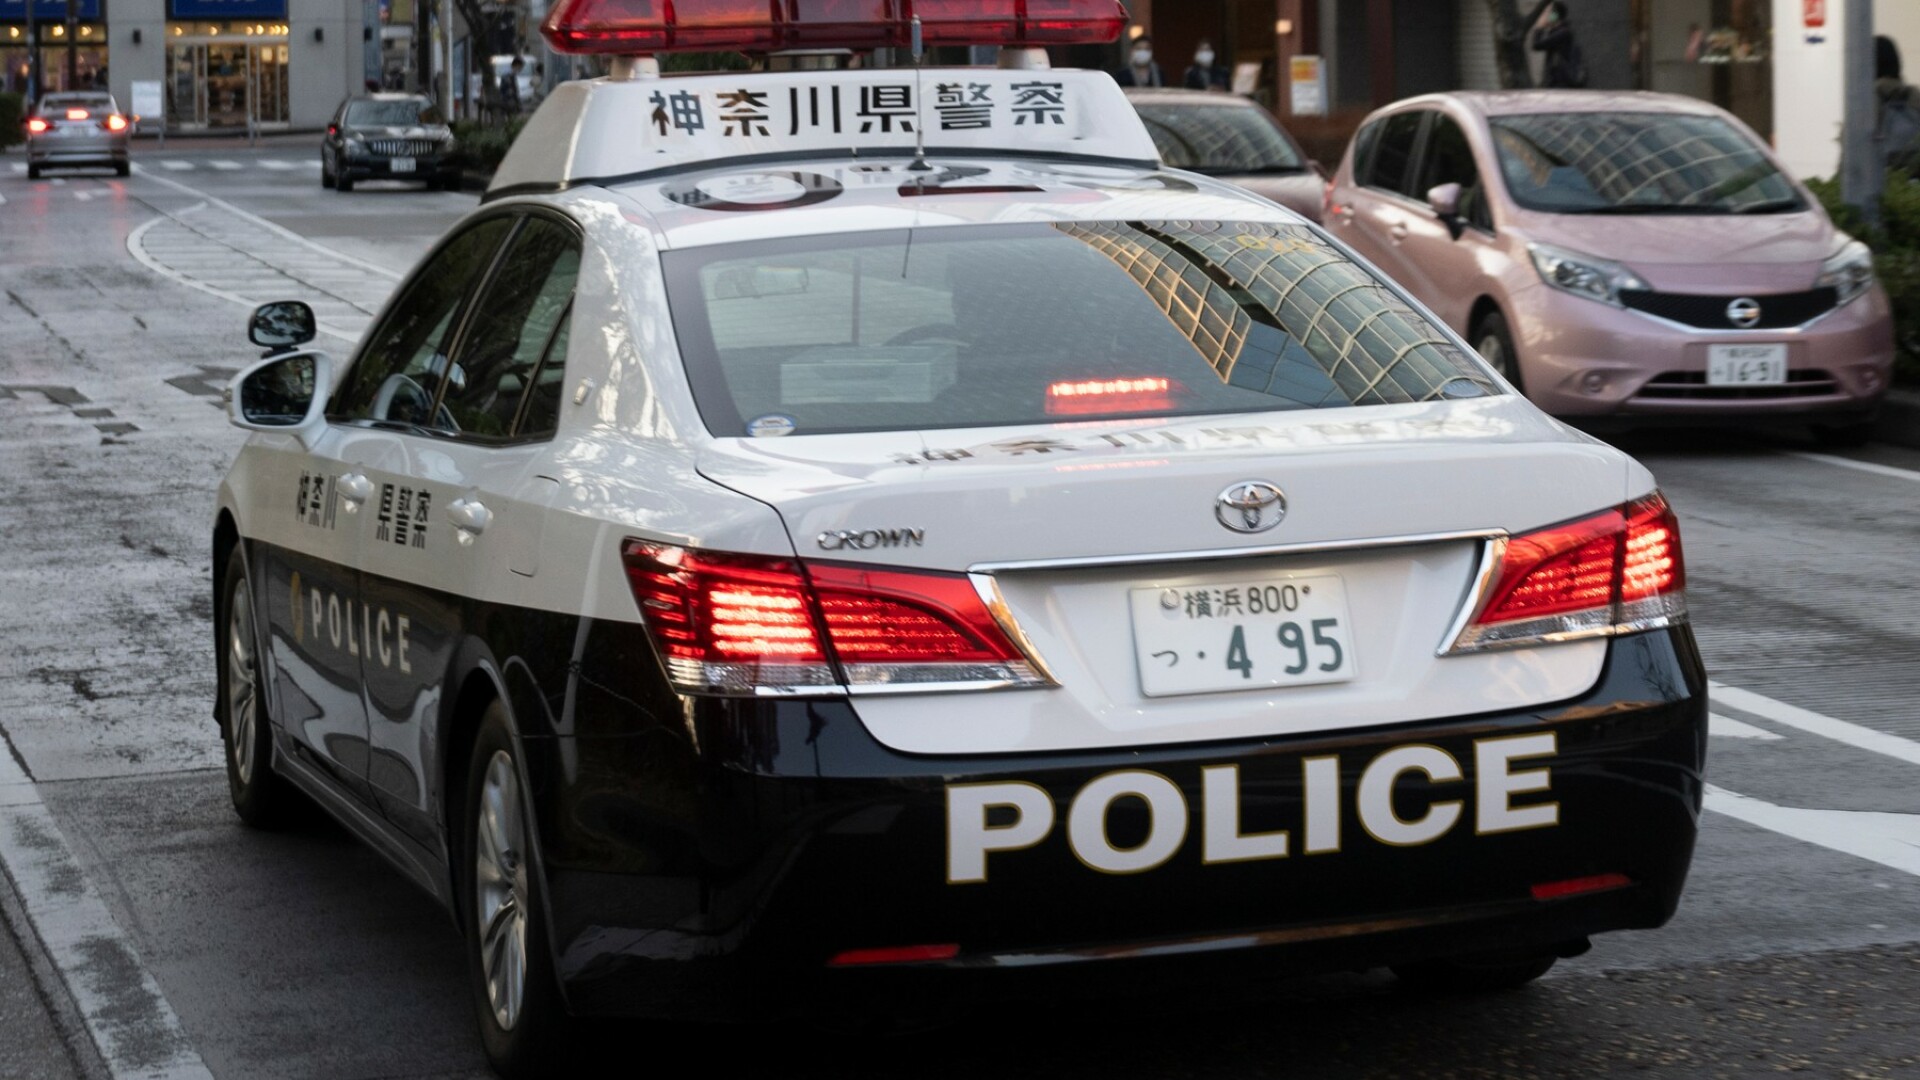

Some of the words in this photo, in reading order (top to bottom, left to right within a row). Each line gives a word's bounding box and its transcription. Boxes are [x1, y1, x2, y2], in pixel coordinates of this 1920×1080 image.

[648, 81, 1066, 137] 神奈川県警察
[817, 526, 925, 551] CROWN
[310, 587, 412, 674] POLICE
[945, 732, 1559, 884] POLICE
